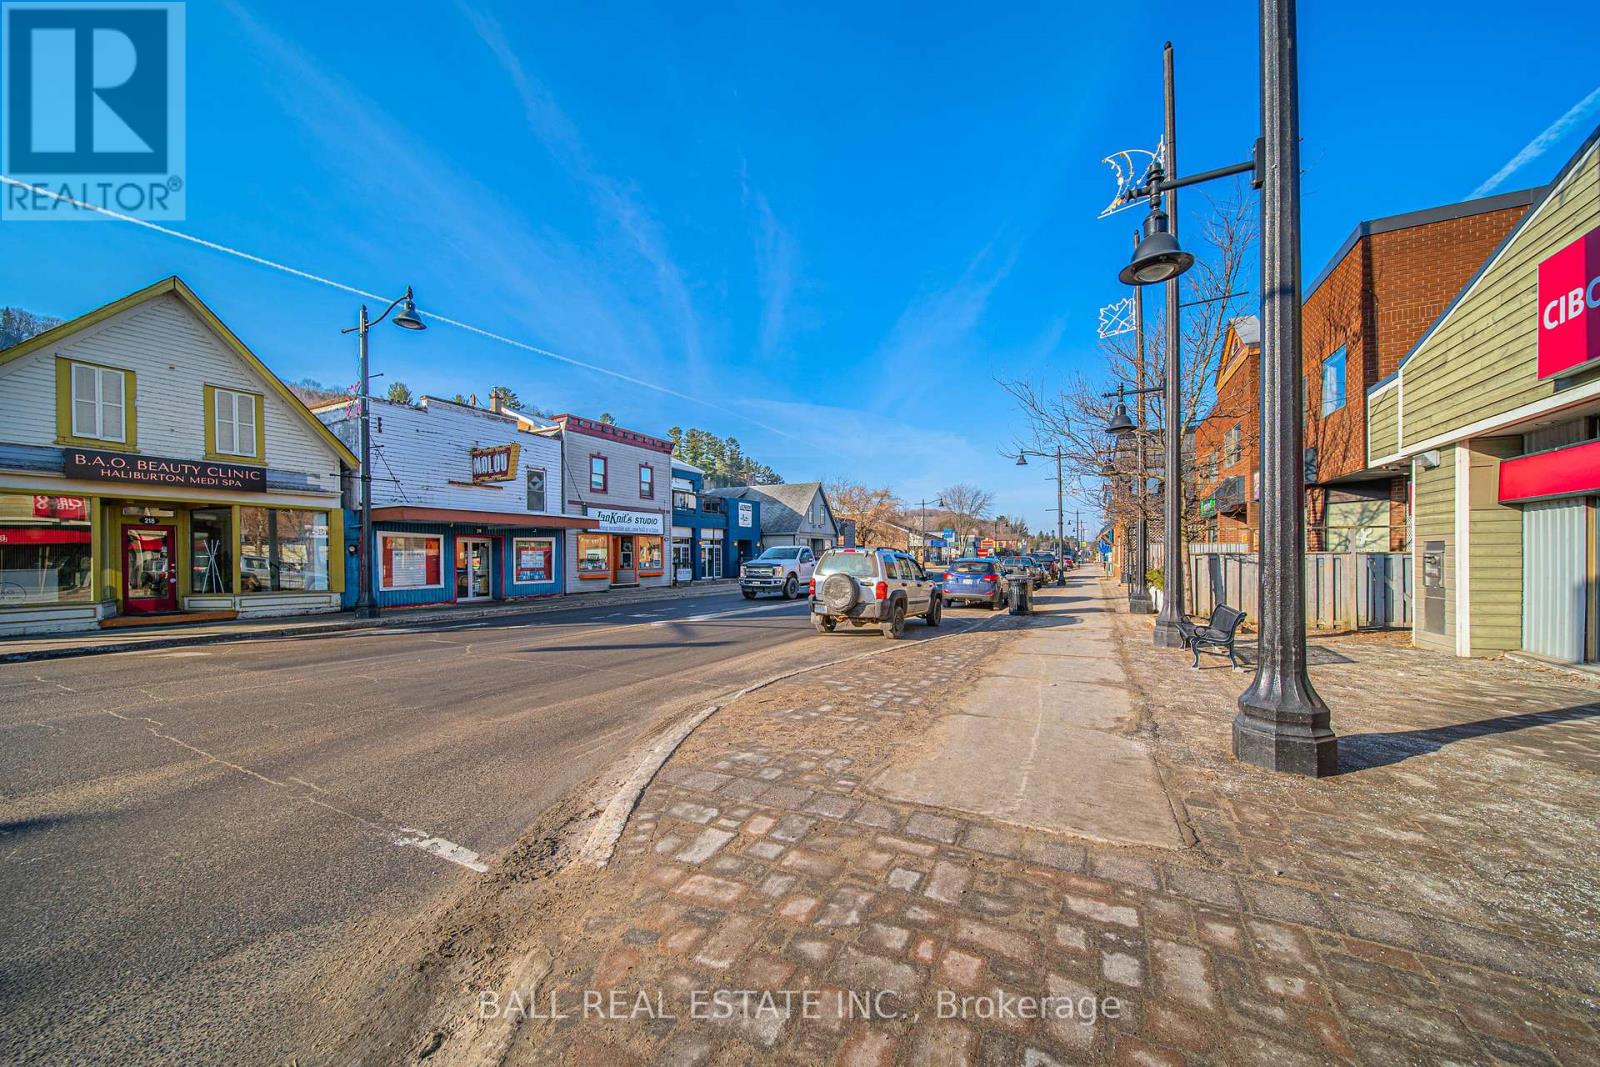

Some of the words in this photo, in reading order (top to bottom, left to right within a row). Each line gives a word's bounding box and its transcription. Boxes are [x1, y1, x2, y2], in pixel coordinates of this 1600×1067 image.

[74, 454, 130, 469] B.A.O.
[137, 460, 201, 475] BEAUTY
[207, 467, 261, 481] CLINIC
[101, 469, 185, 483] HALIBURTON
[189, 476, 218, 485] MEDI
[222, 479, 242, 487] SPA
[635, 517, 658, 525] STUDIO
